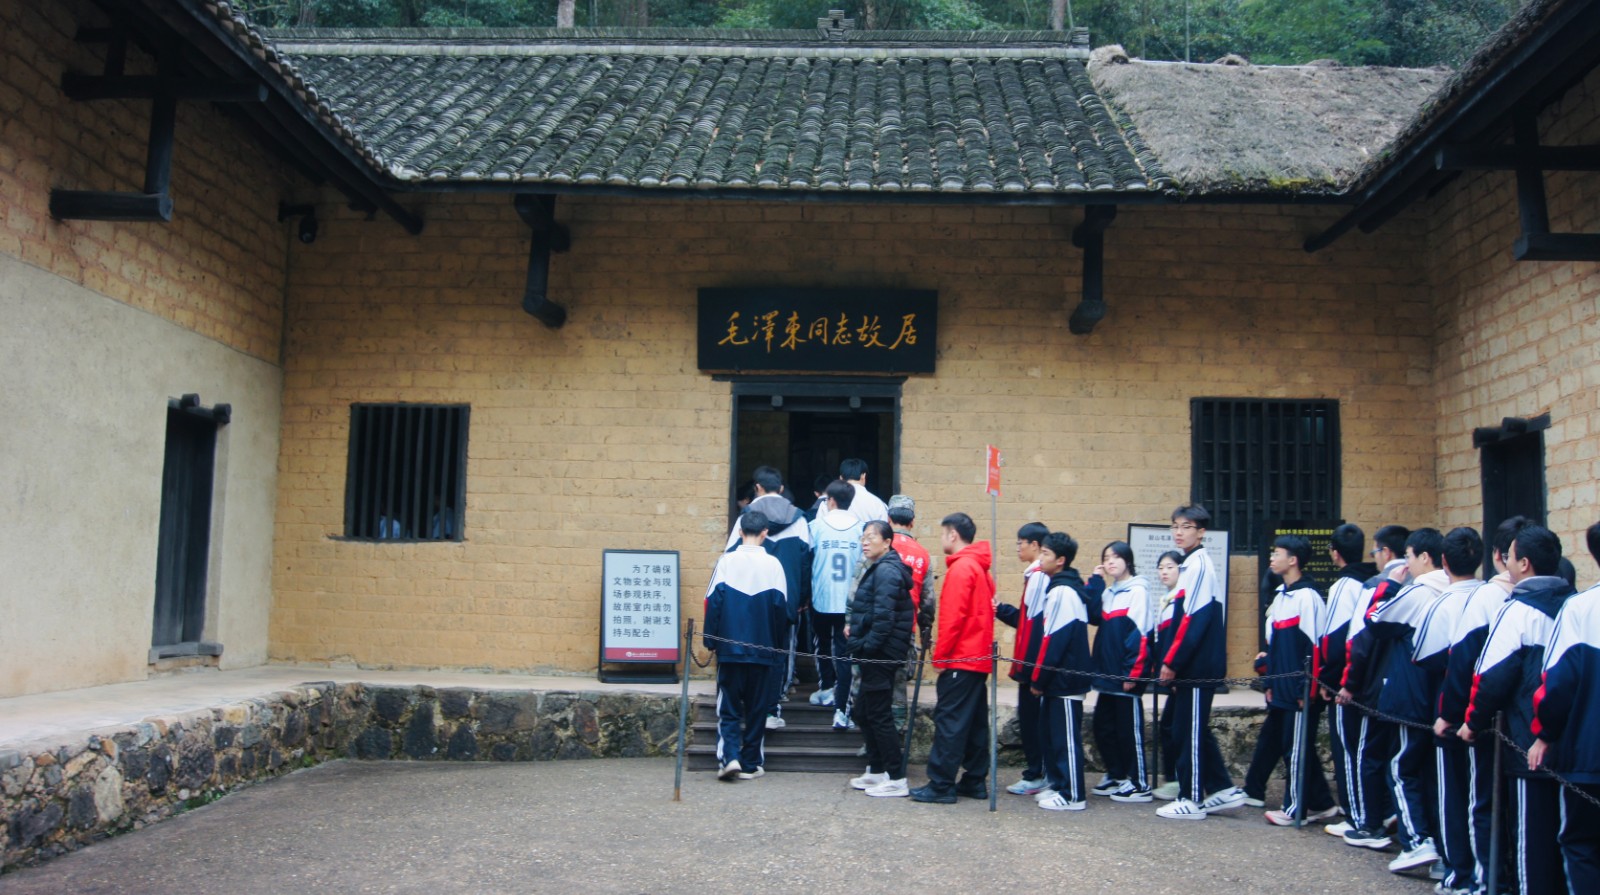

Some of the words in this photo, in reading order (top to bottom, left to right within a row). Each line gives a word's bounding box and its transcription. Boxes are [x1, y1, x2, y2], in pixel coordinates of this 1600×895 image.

[717, 310, 917, 353] 毛澤東同志故居
[632, 564, 672, 574] 为了确保
[832, 553, 847, 582] 9
[613, 577, 672, 587] 文物安全与现
[613, 602, 672, 612] 故居室内请勿
